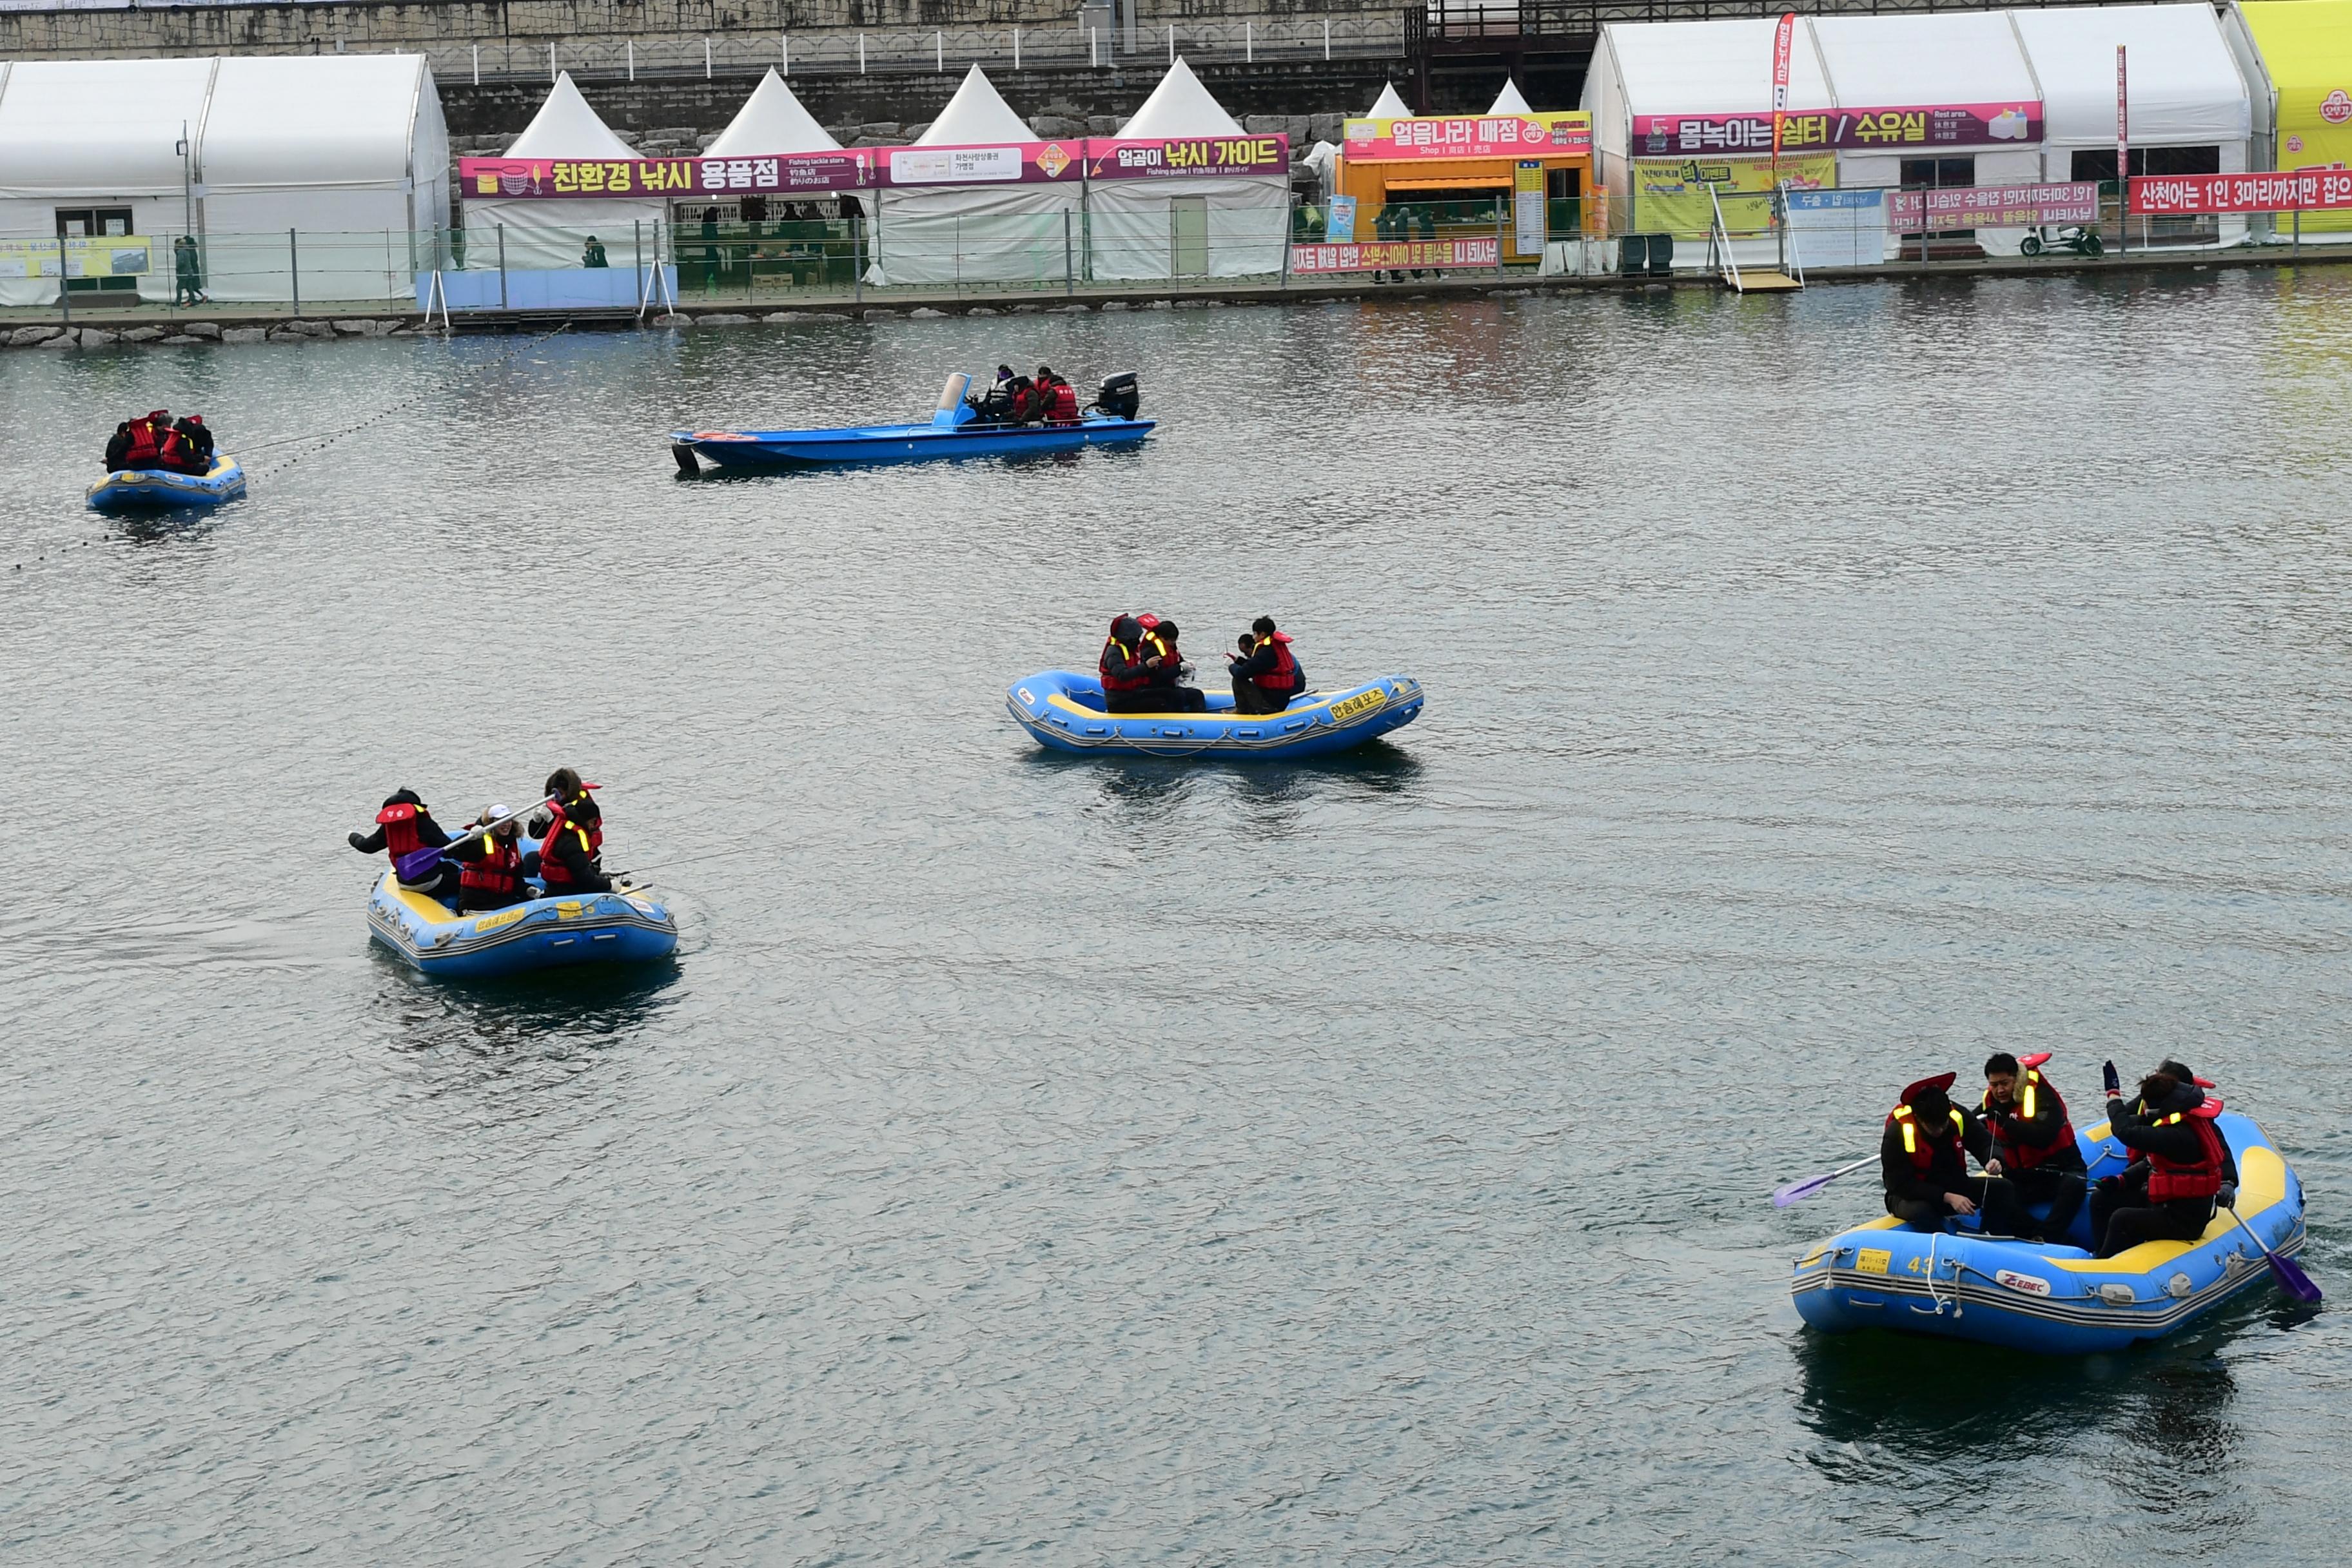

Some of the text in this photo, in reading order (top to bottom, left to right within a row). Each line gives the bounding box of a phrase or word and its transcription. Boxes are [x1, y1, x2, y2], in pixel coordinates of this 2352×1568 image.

[1392, 119, 1518, 146] 얼음나라 매점
[1679, 118, 1773, 150] 몸녹이는
[1781, 115, 1827, 145] 쉼터
[1855, 112, 1925, 143] 수유실
[955, 152, 999, 162] 화천사랑상품권
[1117, 139, 1278, 167] 얼곰이 낚시 가이드
[1420, 146, 1439, 155] Shop
[553, 159, 779, 192] 친환경 낚시 용품점
[955, 162, 974, 171] 가맹점
[1146, 168, 1169, 176] Fishing
[1700, 168, 1729, 181] 이벤트
[2140, 181, 2200, 210] 산천어는
[2206, 180, 2228, 207] 1인
[2234, 177, 2317, 207] 3마리까지만
[1330, 689, 1385, 719] 한송레포츠
[2004, 1273, 2045, 1292] ZEBEC
